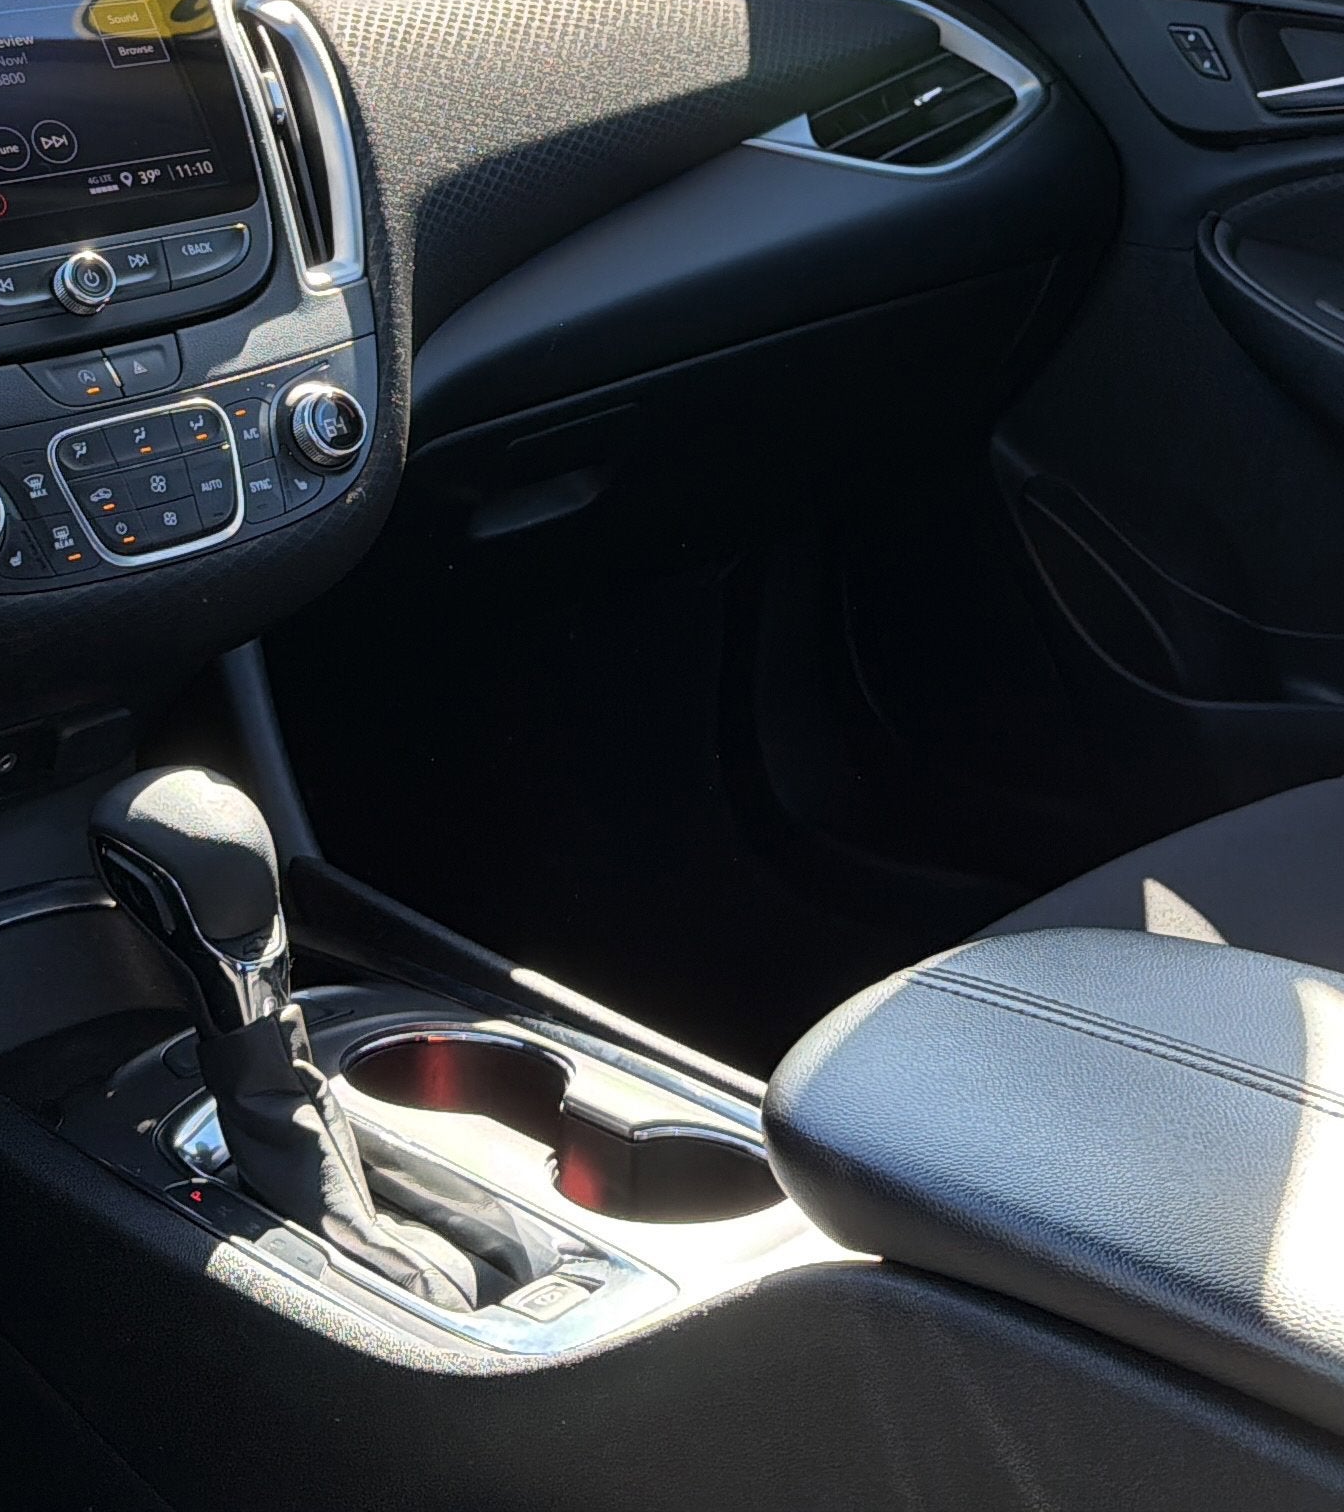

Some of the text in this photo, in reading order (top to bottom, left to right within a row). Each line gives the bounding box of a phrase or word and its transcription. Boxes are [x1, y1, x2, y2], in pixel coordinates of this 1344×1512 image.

[107, 12, 139, 25] Sound
[117, 42, 154, 57] Browse
[175, 160, 214, 178] 11:10
[87, 173, 114, 184] 4G LTE
[188, 241, 213, 256] BACK
[323, 415, 349, 438] 64
[242, 427, 260, 441] A/C
[201, 478, 223, 492] AUTO
[249, 478, 273, 493] SYNC
[29, 488, 48, 499] MAX
[54, 538, 75, 550] REAR
